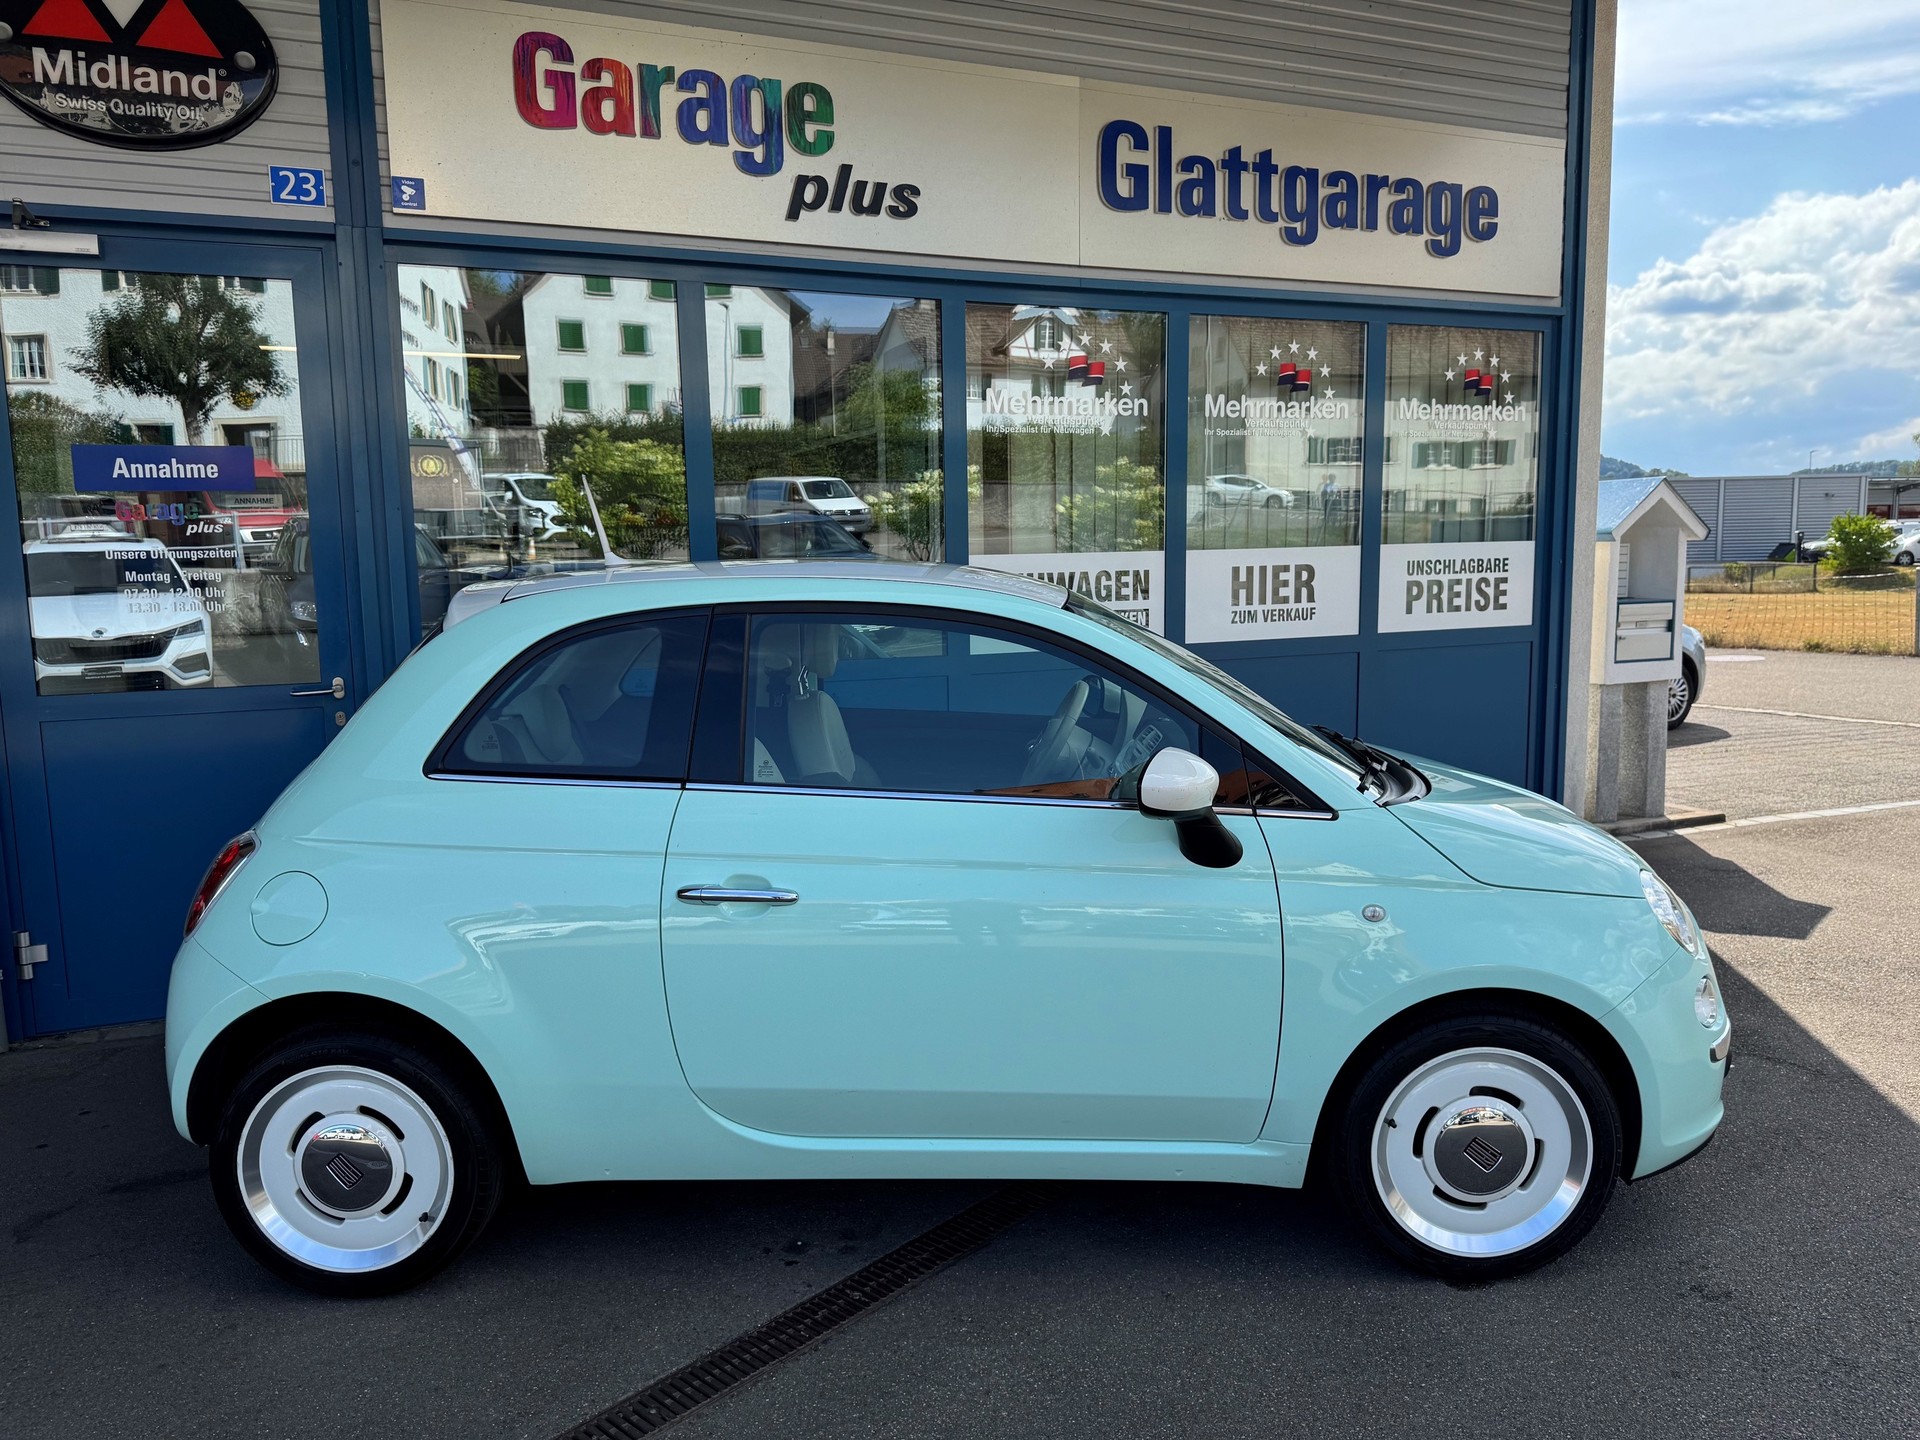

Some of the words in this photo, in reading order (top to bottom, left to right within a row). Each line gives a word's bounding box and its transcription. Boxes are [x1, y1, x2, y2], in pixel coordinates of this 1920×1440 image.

[55, 92, 107, 112] Swiss
[110, 97, 174, 121] Quality
[511, 31, 836, 177] Garage
[278, 170, 318, 202] 23
[784, 163, 922, 222] plus
[1097, 119, 1500, 259] Glattgarage
[985, 388, 1149, 417] Mehrmarken
[1204, 393, 1349, 418] Mehrmarken
[1399, 397, 1526, 422] Mehrmarken
[1000, 425, 1039, 435] Spezialist
[1053, 425, 1095, 436] Neuwagen
[1244, 418, 1309, 430] Verkaufspunkt
[1434, 420, 1491, 431] Verkaufspunkt
[111, 456, 220, 479] Annahme
[114, 500, 200, 526] Garage
[233, 497, 275, 505] ANNAHME
[185, 520, 224, 536] plus
[105, 549, 147, 560] Unsere
[125, 570, 171, 584] Montag
[181, 570, 222, 583] Freitag
[1406, 557, 1510, 577] UNSCHLAGBARE
[205, 586, 226, 598] Uhr
[1018, 569, 1150, 603] WAGEN
[1230, 563, 1316, 607] HIER
[1405, 576, 1509, 615] PREISE
[206, 600, 227, 613] Uhr
[1230, 609, 1258, 625] ZUM
[1261, 606, 1317, 623] VERKAUF
